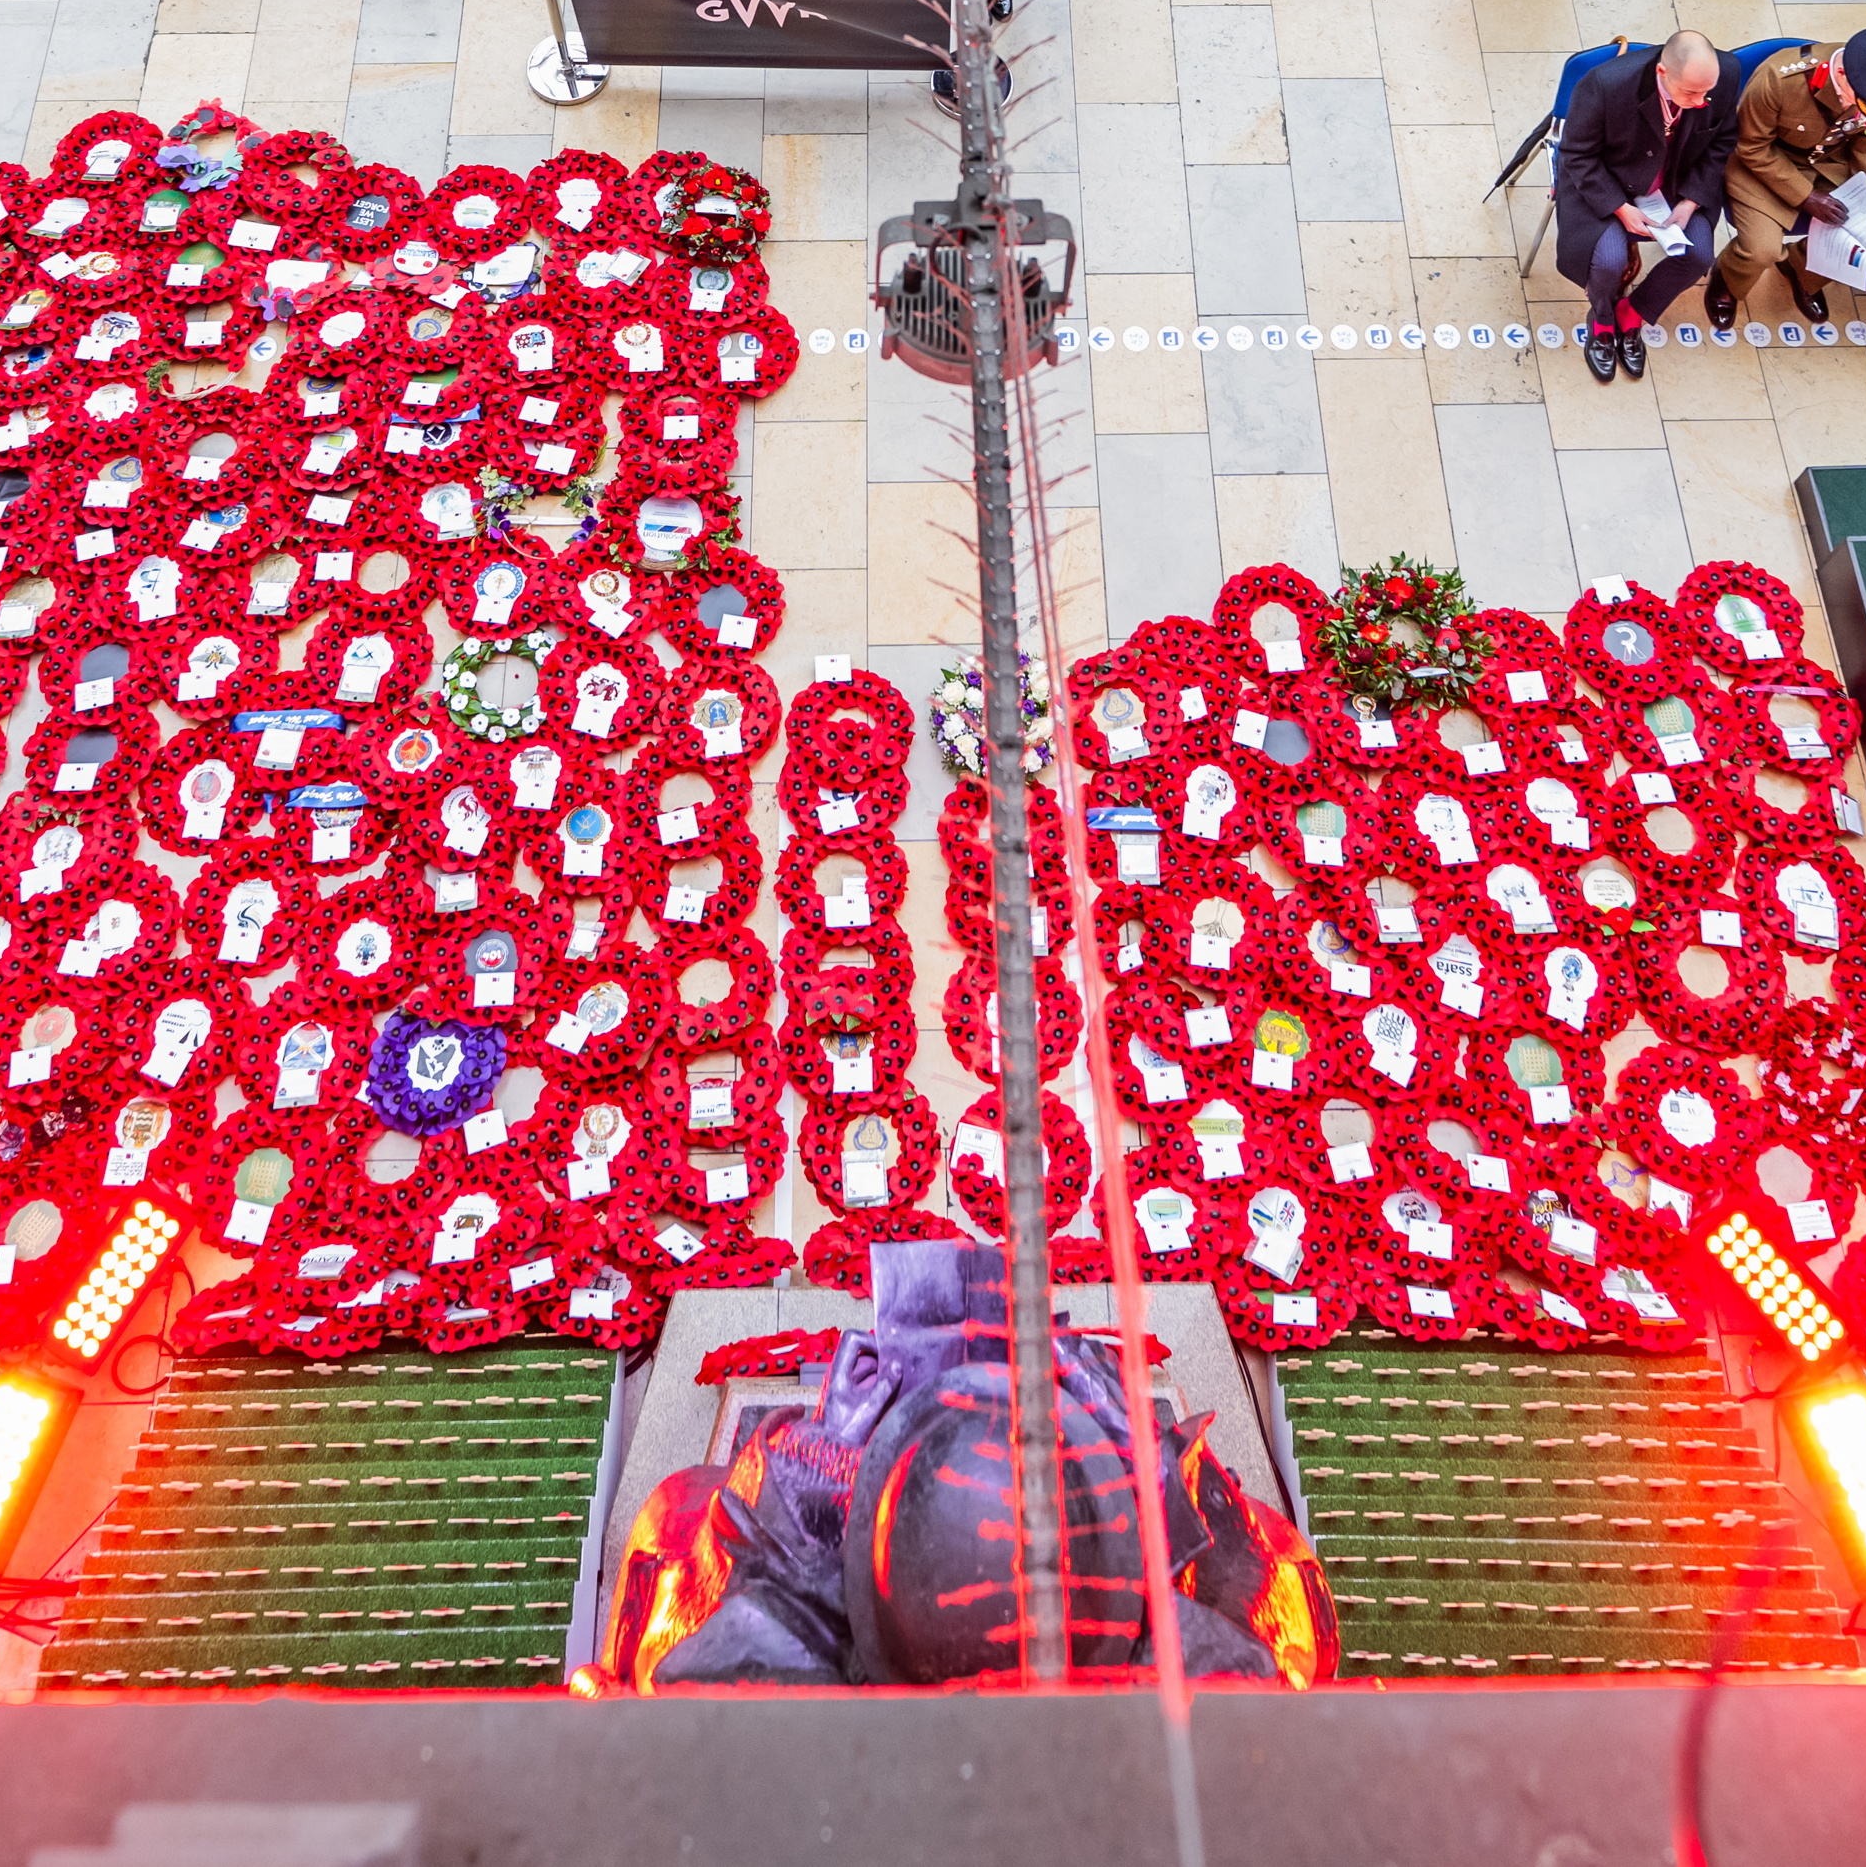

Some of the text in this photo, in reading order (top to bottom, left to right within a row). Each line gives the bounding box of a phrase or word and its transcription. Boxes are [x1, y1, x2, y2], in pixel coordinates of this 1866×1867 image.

[352, 199, 389, 213] FORGET
[359, 209, 374, 219] WE
[352, 217, 375, 227] LEST
[247, 714, 282, 726] Forget
[286, 714, 303, 726] We
[300, 790, 353, 803] We Forget
[240, 895, 265, 905] Newport
[482, 950, 501, 961] 104
[1436, 961, 1472, 978] ssafa
[166, 1012, 187, 1020] CHARITY
[161, 1019, 185, 1028] VETERANS
[1193, 1124, 1225, 1132] Worcester
